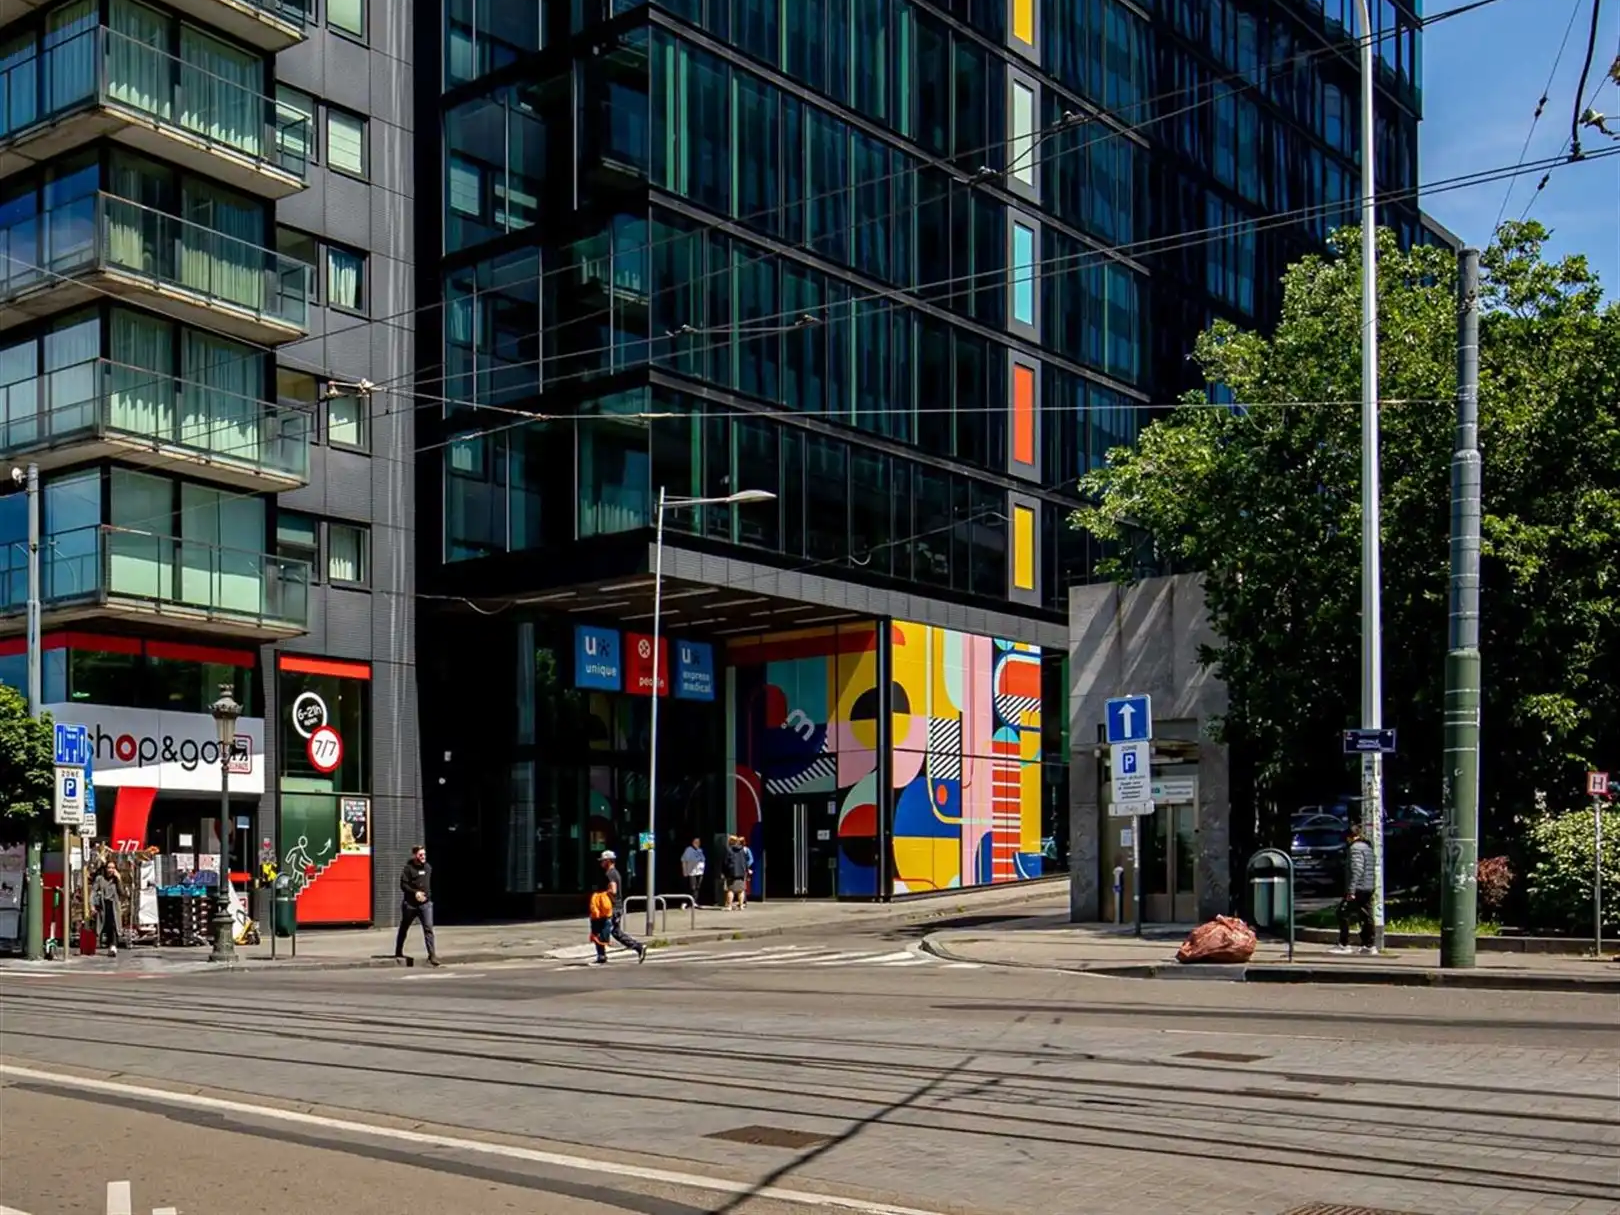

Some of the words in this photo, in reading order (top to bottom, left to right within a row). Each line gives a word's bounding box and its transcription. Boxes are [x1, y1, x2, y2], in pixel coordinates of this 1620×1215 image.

[585, 663, 617, 678] unique
[314, 739, 337, 758] 7/7
[61, 770, 80, 778] ZONE
[1592, 776, 1604, 790] H
[116, 839, 140, 851] 7/7
